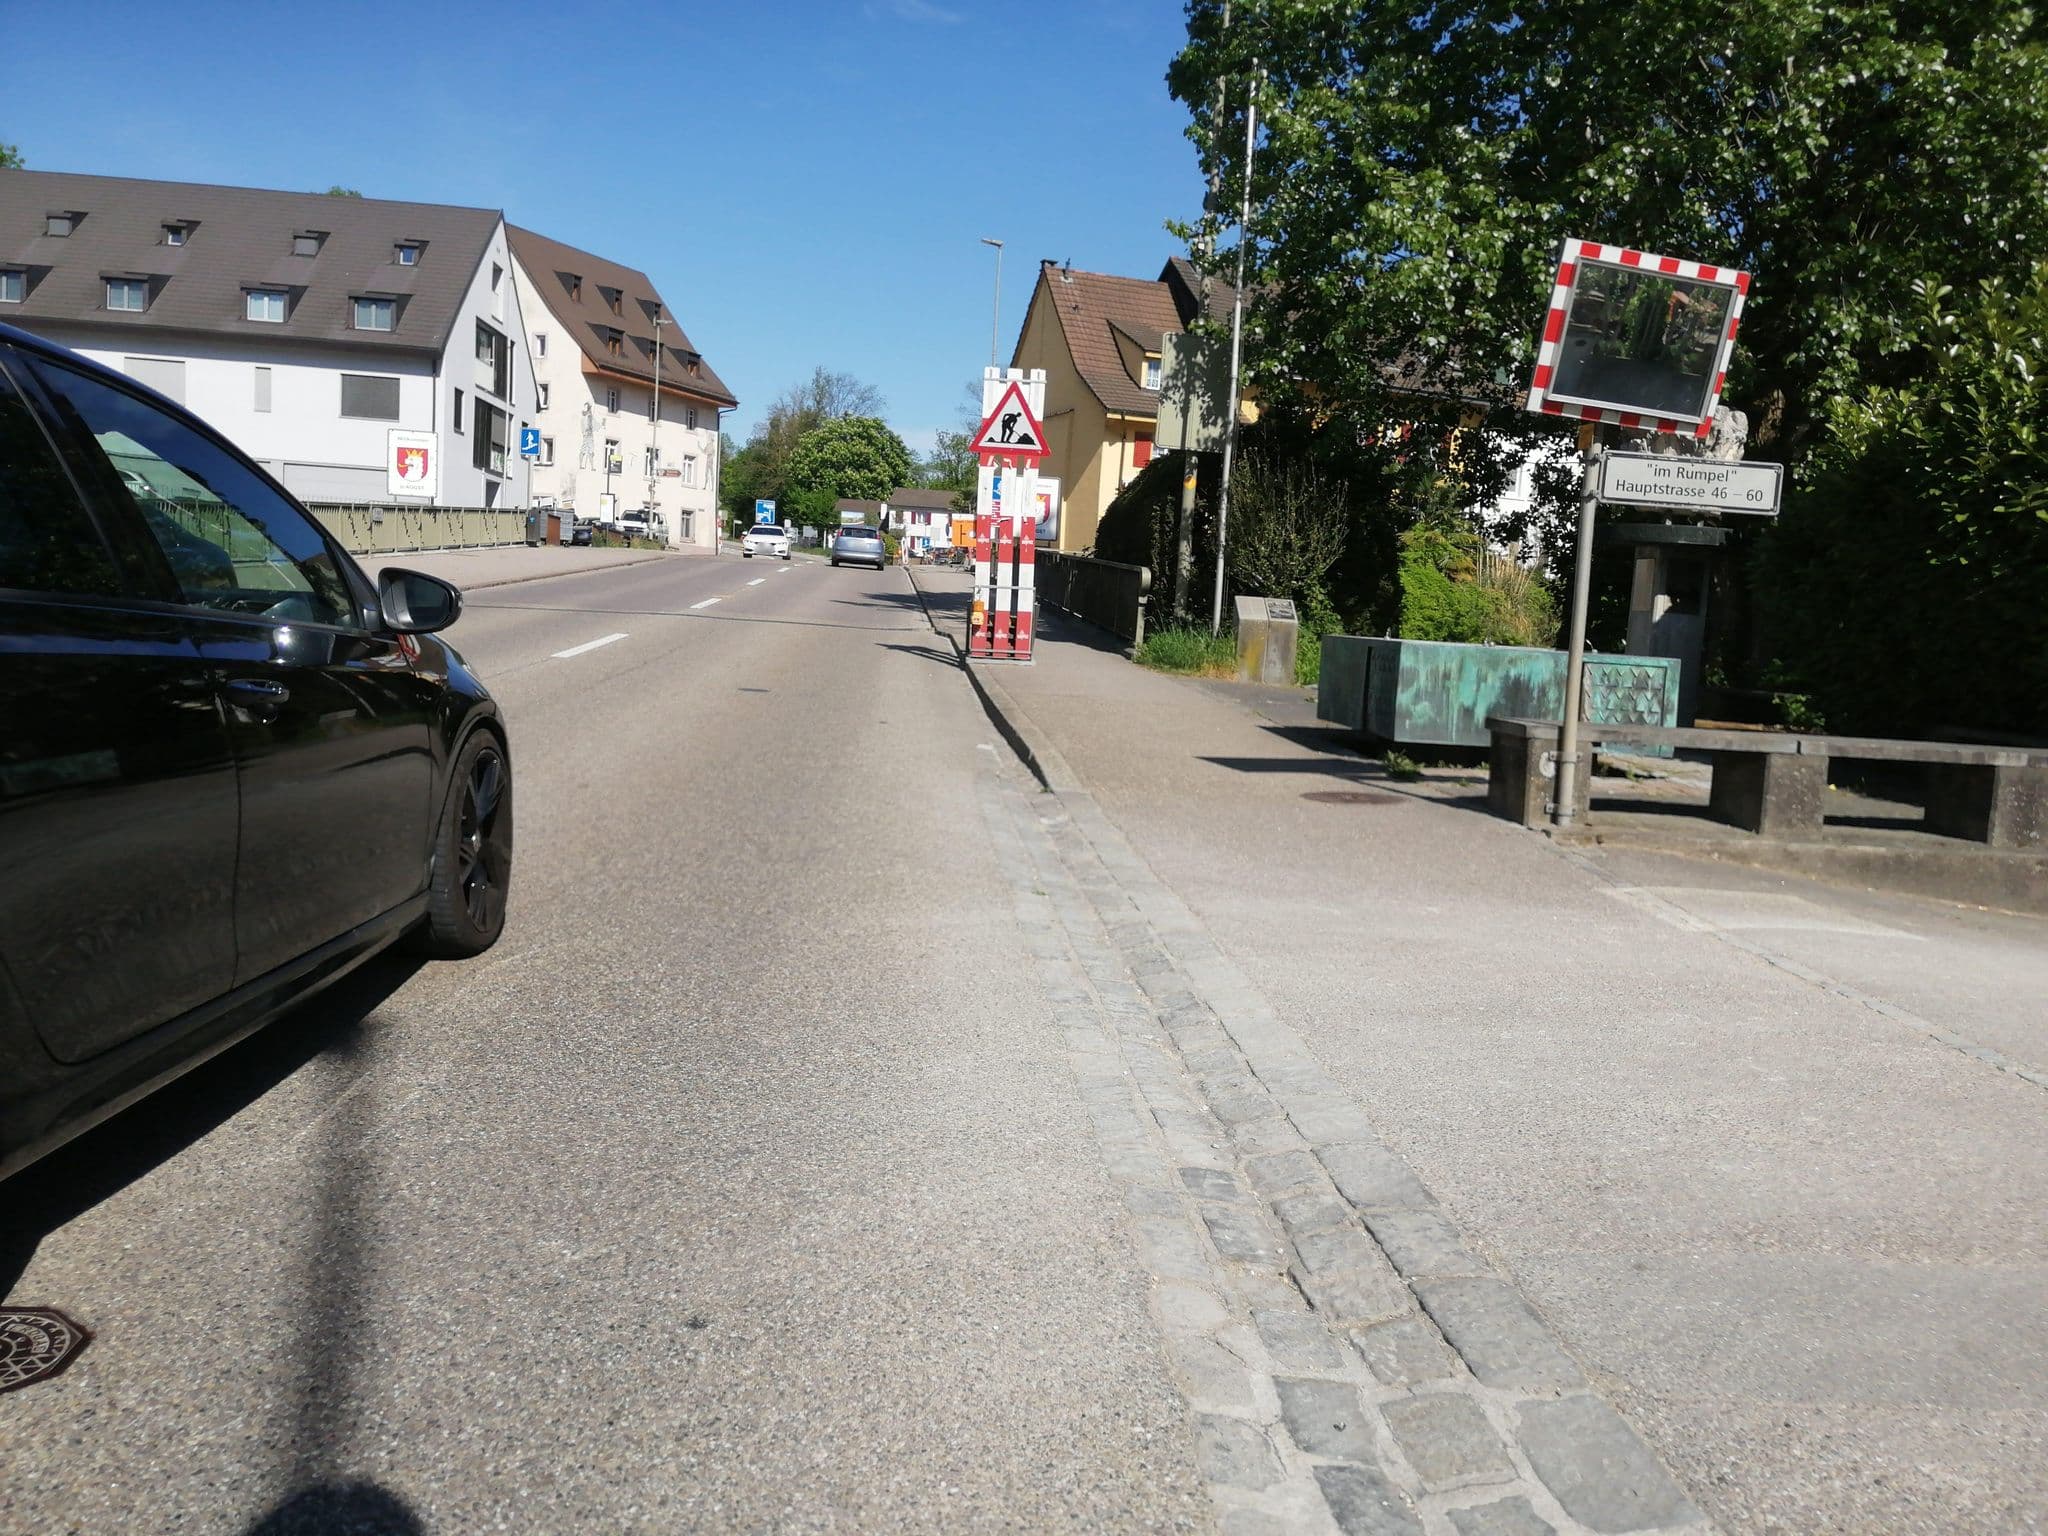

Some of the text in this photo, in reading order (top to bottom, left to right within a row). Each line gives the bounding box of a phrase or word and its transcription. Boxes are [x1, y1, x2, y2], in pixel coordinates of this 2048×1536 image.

[1676, 466, 1737, 484] Rumpel"
[1616, 479, 1706, 497] Hauptstrasse
[1711, 487, 1728, 499] 46
[1746, 489, 1763, 502] 60
